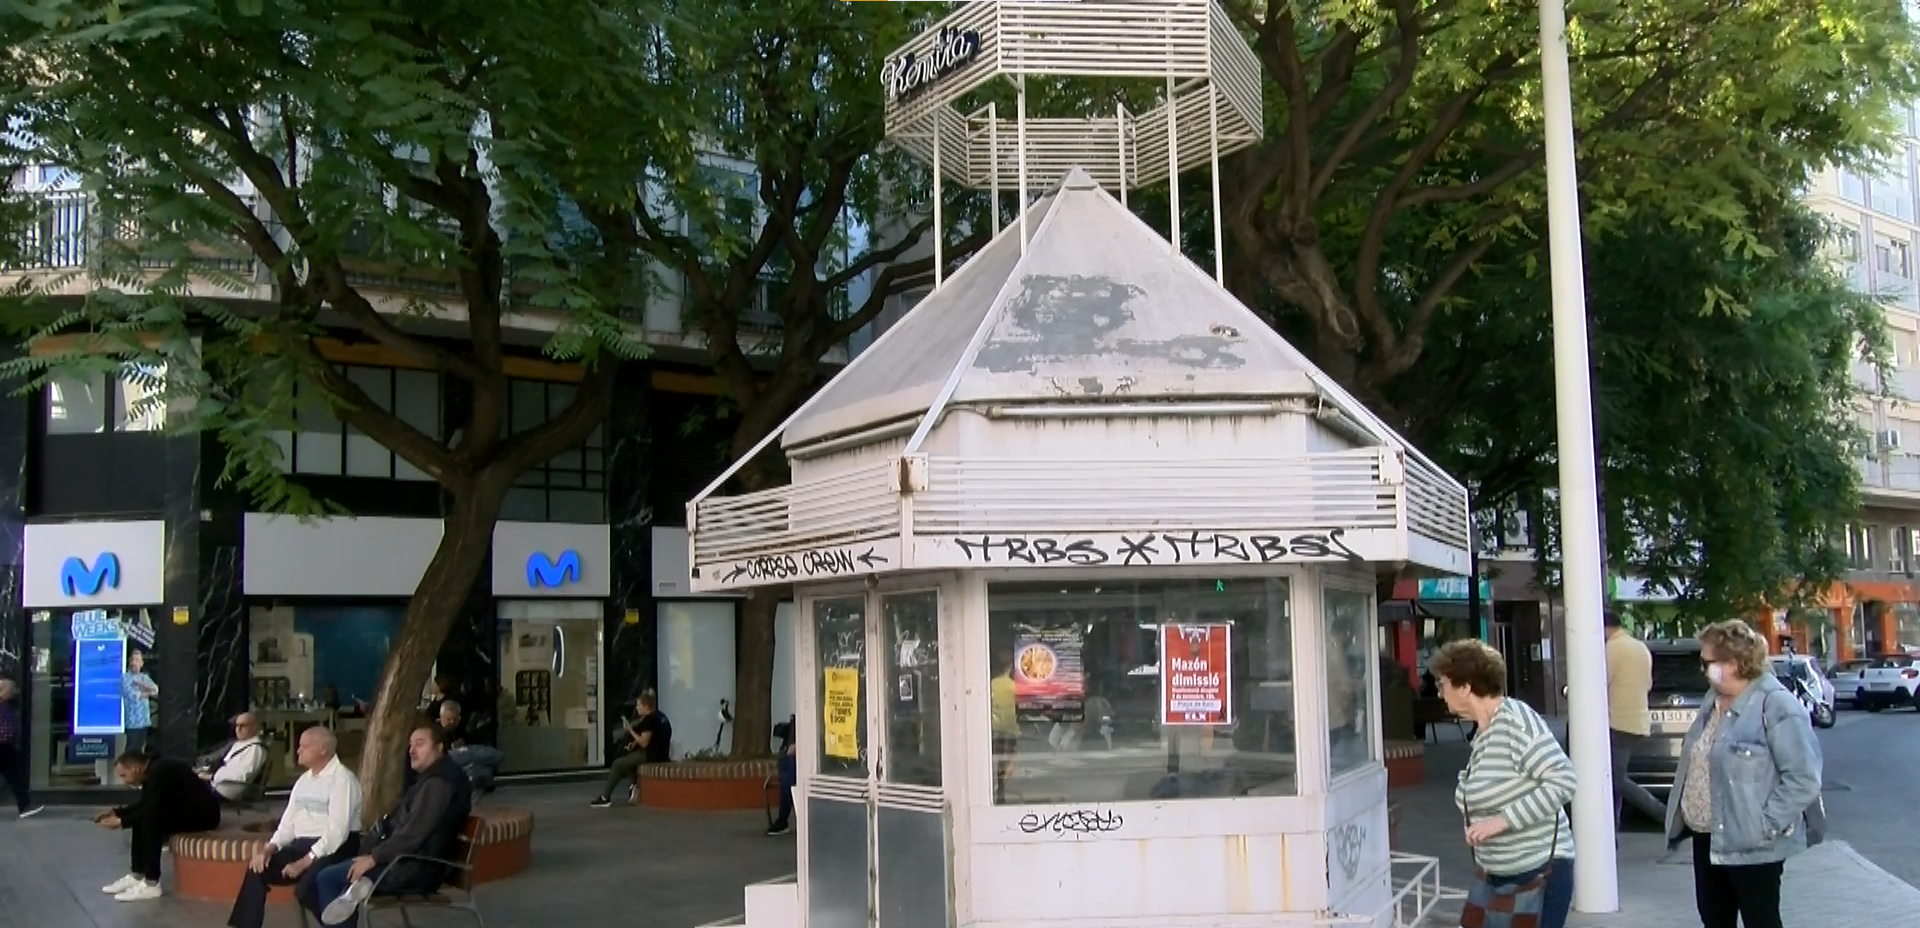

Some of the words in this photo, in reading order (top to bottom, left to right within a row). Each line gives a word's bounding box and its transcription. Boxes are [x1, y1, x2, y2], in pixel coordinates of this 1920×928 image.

[74, 609, 106, 623] BLUE
[75, 621, 118, 638] WEEKS
[1171, 657, 1207, 671] Mazón
[1171, 672, 1220, 687] dimissió
[1651, 711, 1682, 721] 0130
